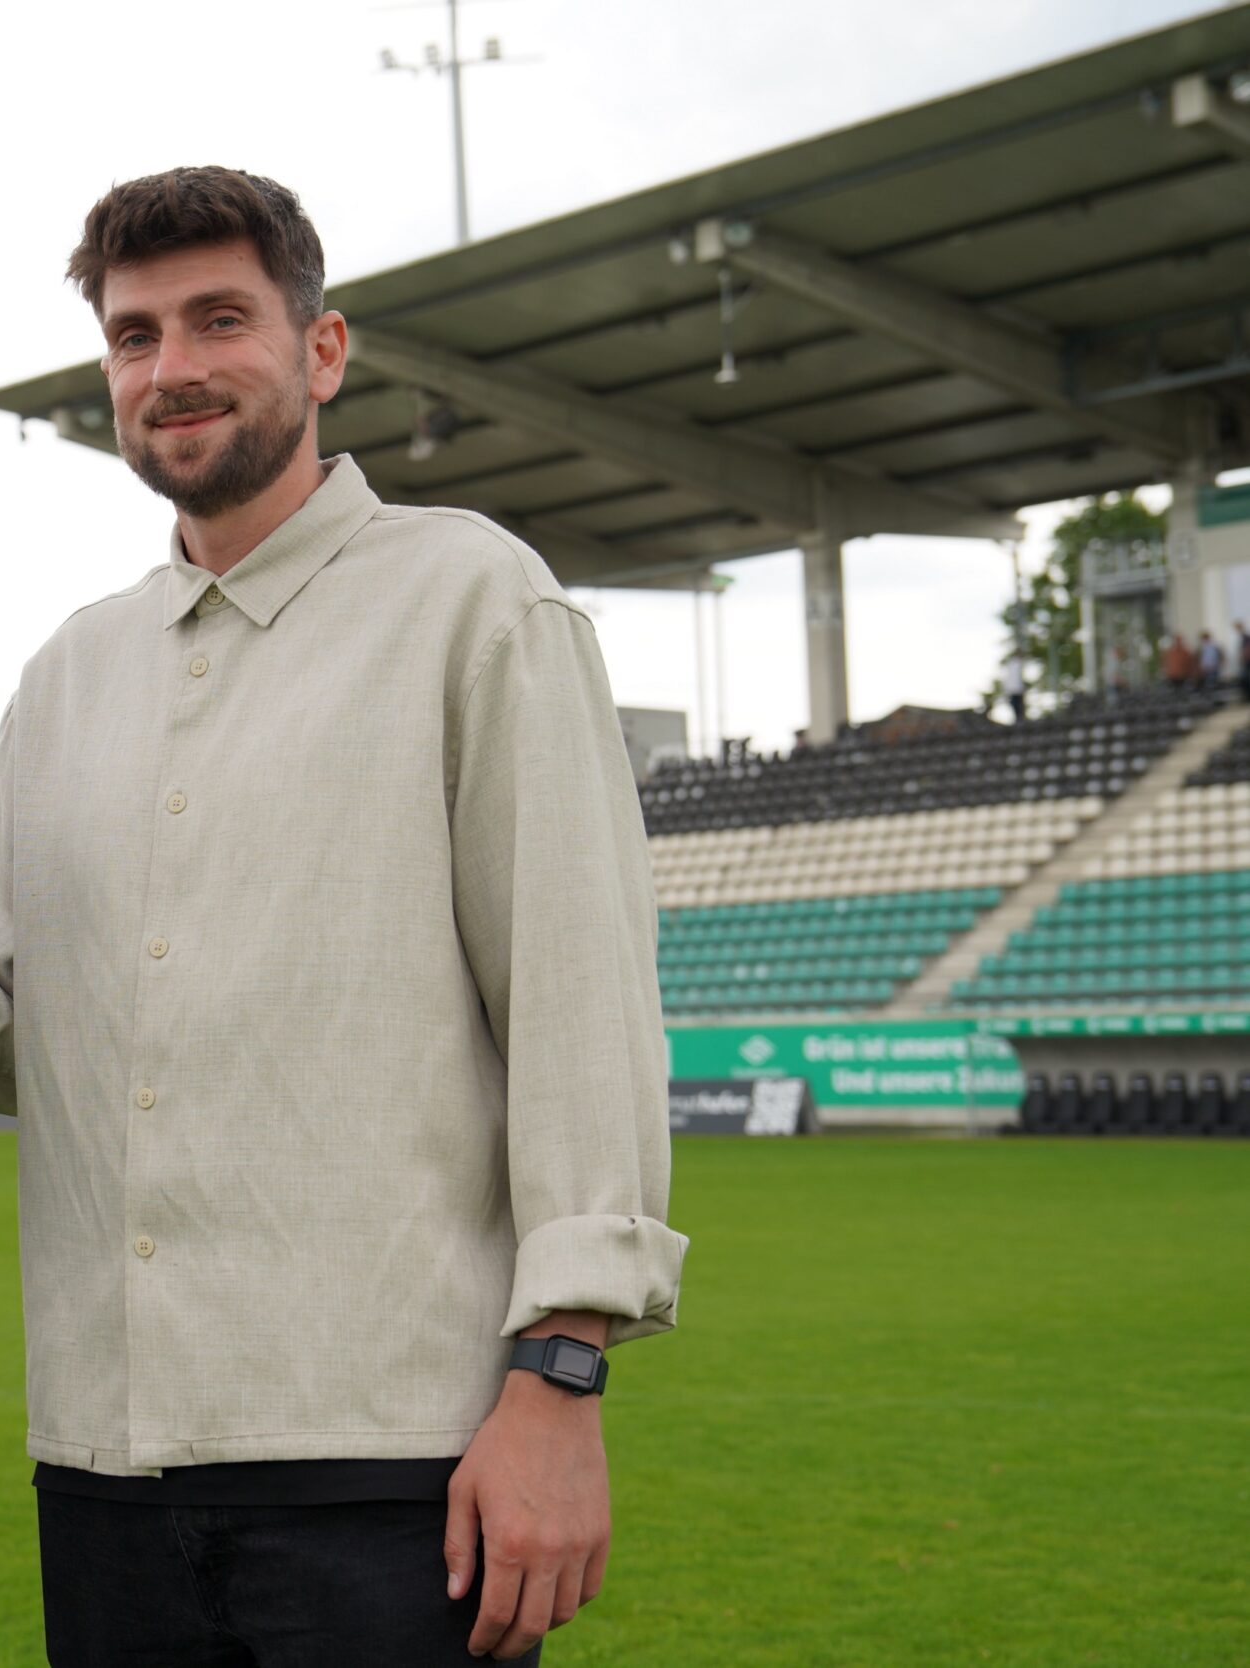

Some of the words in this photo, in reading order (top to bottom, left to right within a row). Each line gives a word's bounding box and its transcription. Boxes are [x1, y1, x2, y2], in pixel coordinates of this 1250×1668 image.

[889, 1037, 968, 1061] unsere
[832, 1068, 874, 1094] Und
[878, 1072, 953, 1094] unsere
